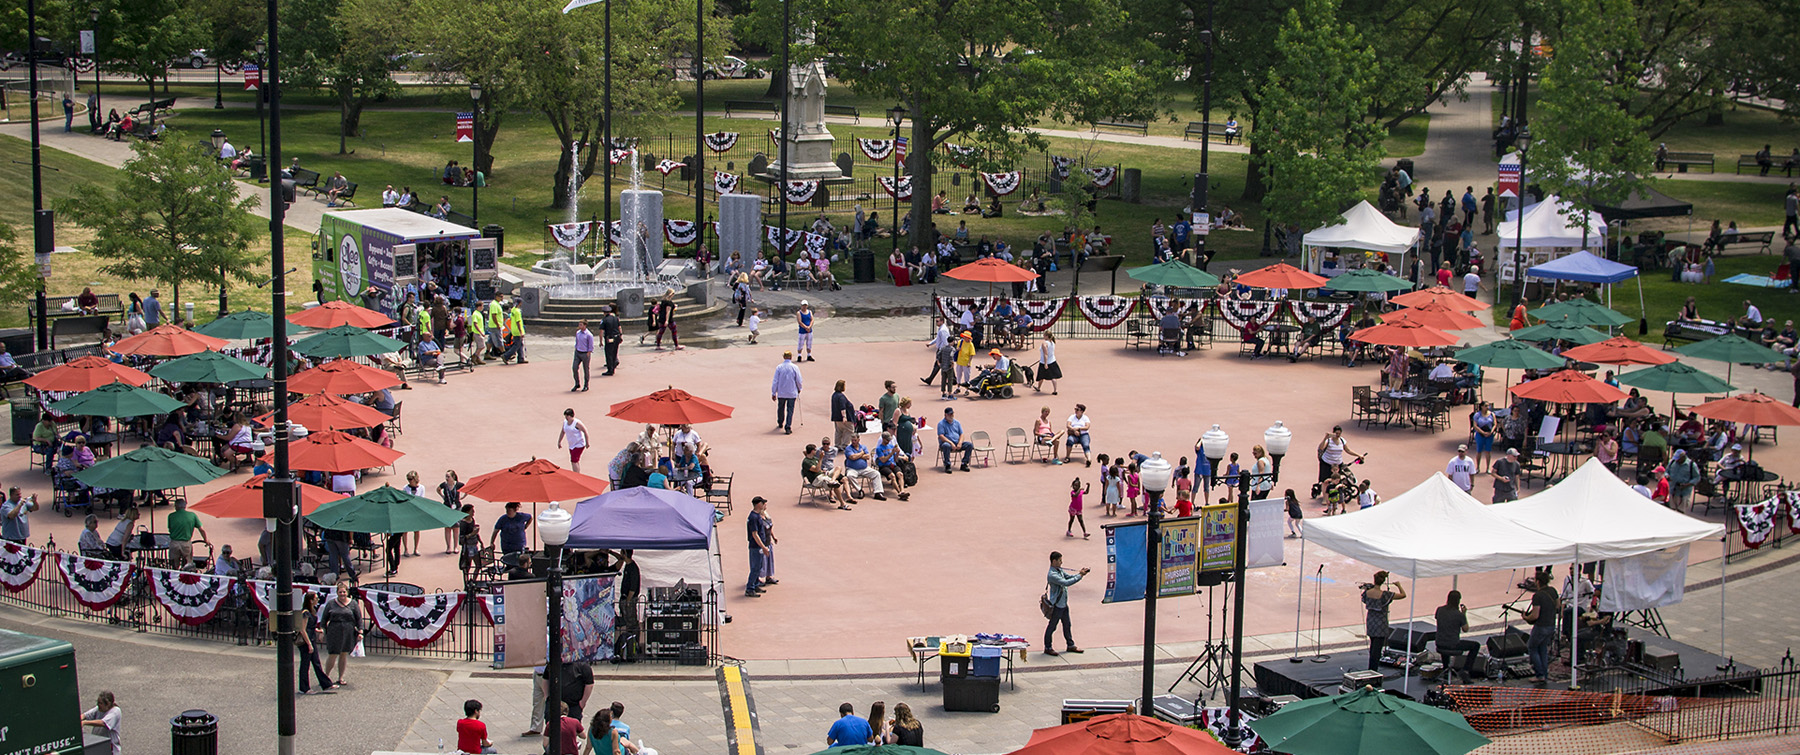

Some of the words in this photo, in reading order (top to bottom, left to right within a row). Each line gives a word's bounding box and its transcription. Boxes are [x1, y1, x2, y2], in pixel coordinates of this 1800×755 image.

[342, 241, 359, 272] glee
[1171, 529, 1188, 542] OUT
[1206, 544, 1231, 556] THURSDAYS
[1164, 567, 1190, 580] THURSDAYS
